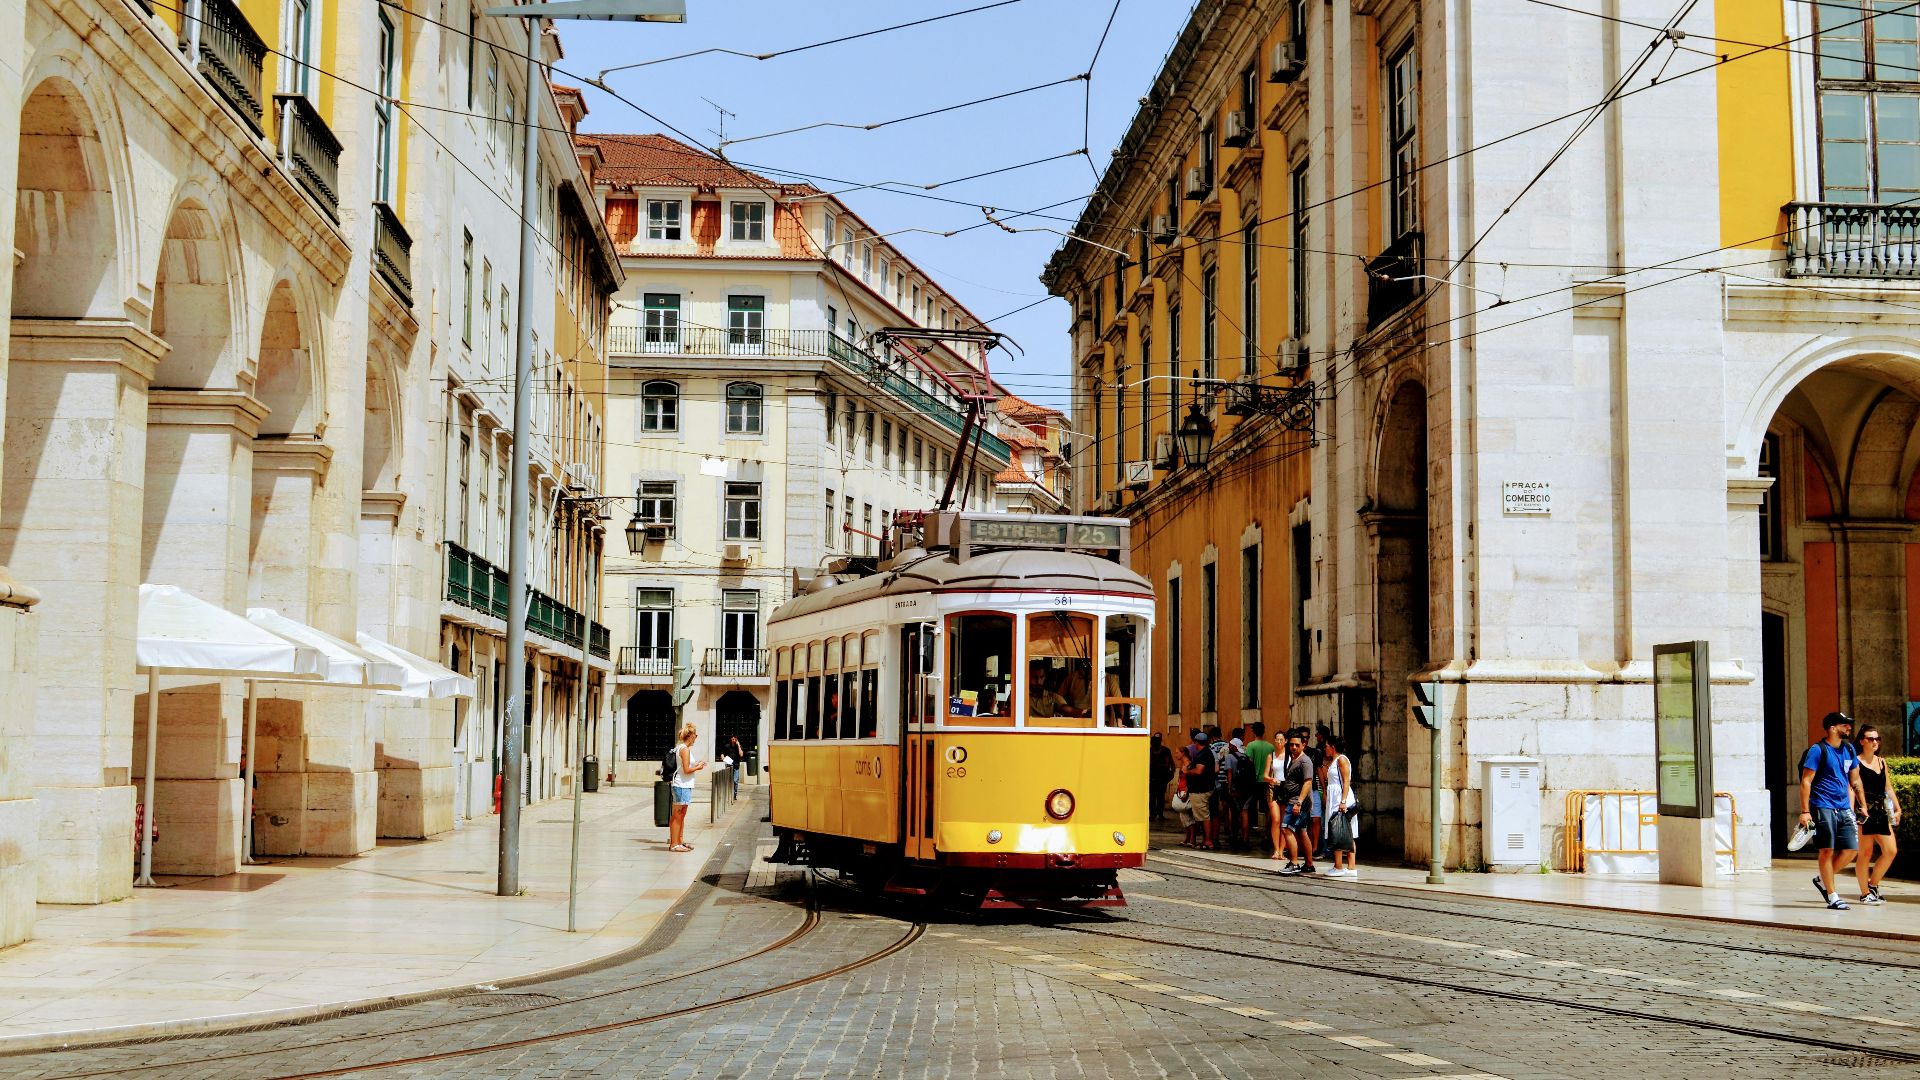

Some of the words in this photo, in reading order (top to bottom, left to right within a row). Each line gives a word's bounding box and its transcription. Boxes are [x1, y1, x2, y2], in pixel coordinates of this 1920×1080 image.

[1511, 482, 1544, 491] PRAÇA
[1505, 494, 1551, 502] COMERCIO
[976, 522, 1059, 538] ESTRELA
[1077, 526, 1106, 544] 25
[1054, 596, 1072, 606] 581
